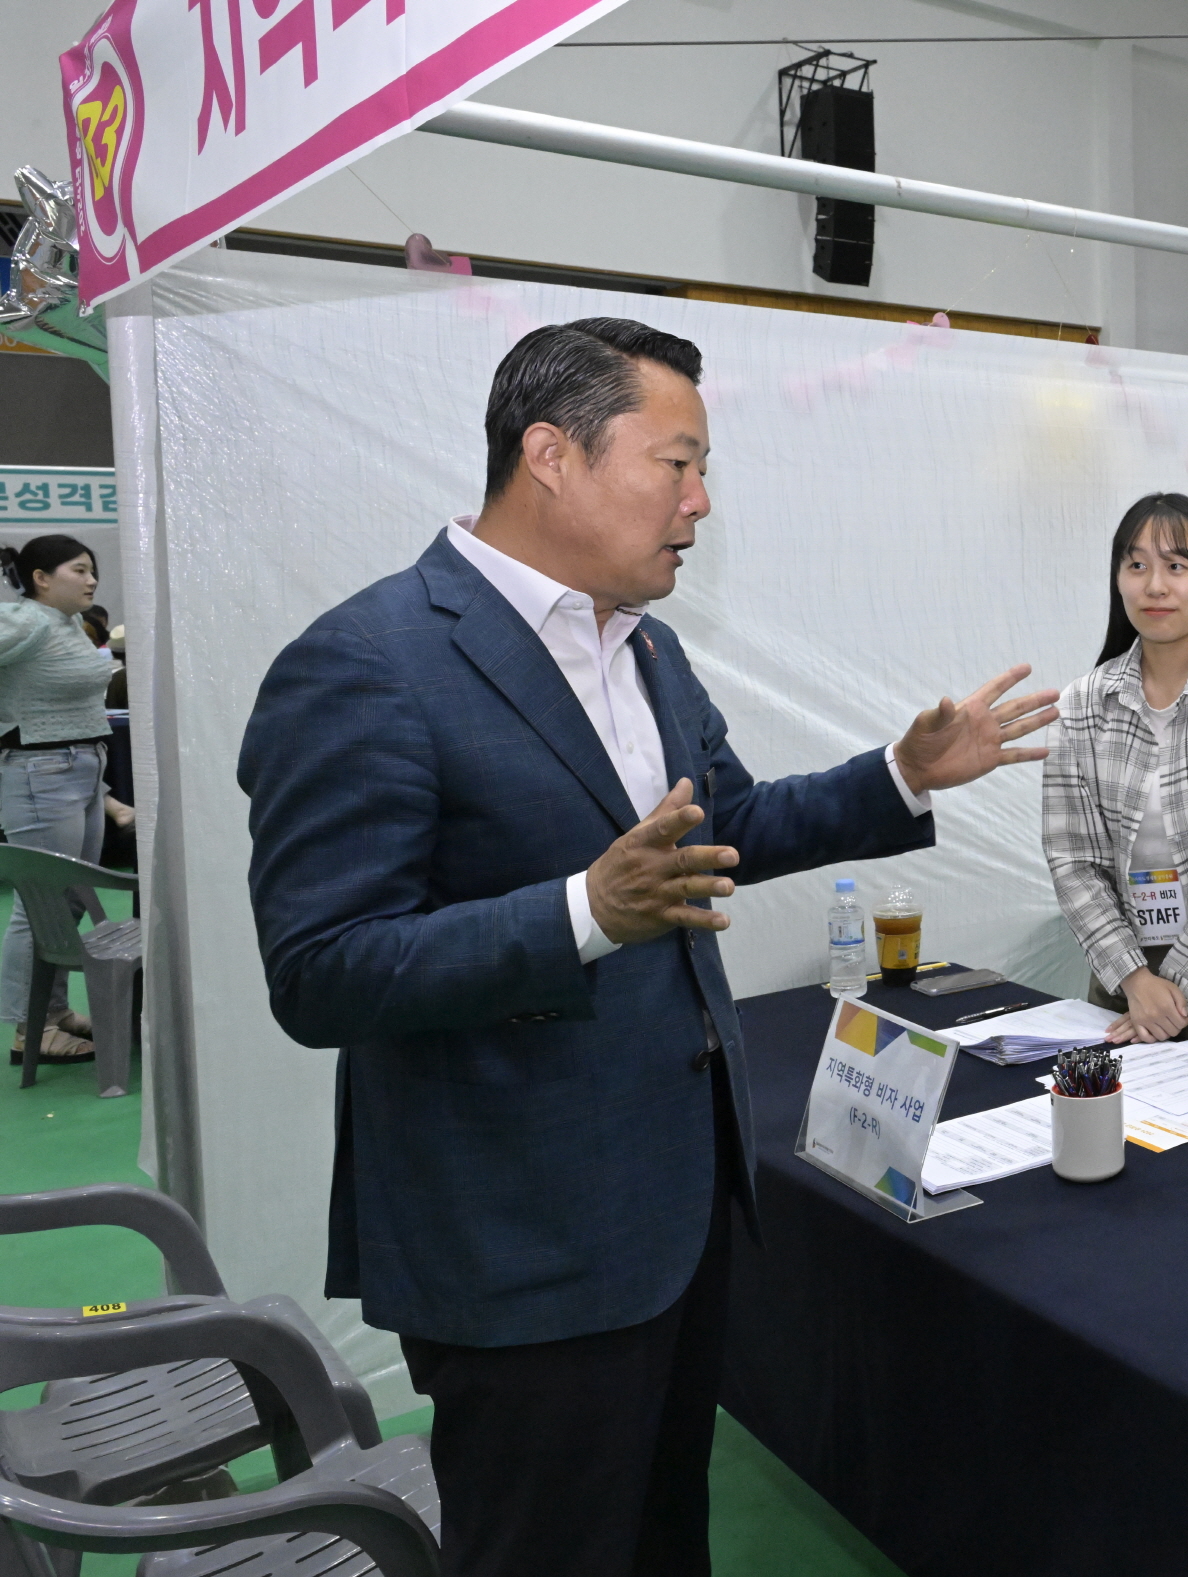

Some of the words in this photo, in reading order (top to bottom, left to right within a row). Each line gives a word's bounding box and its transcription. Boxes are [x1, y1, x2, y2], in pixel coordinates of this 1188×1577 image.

[1159, 889, 1177, 900] 비자
[1137, 906, 1180, 926] STAFF
[826, 1057, 875, 1097] 지역특화형
[876, 1082, 898, 1110] 비자
[900, 1095, 925, 1123] 사업
[849, 1106, 881, 1140] (F-2-R)
[89, 1303, 121, 1313] 408
